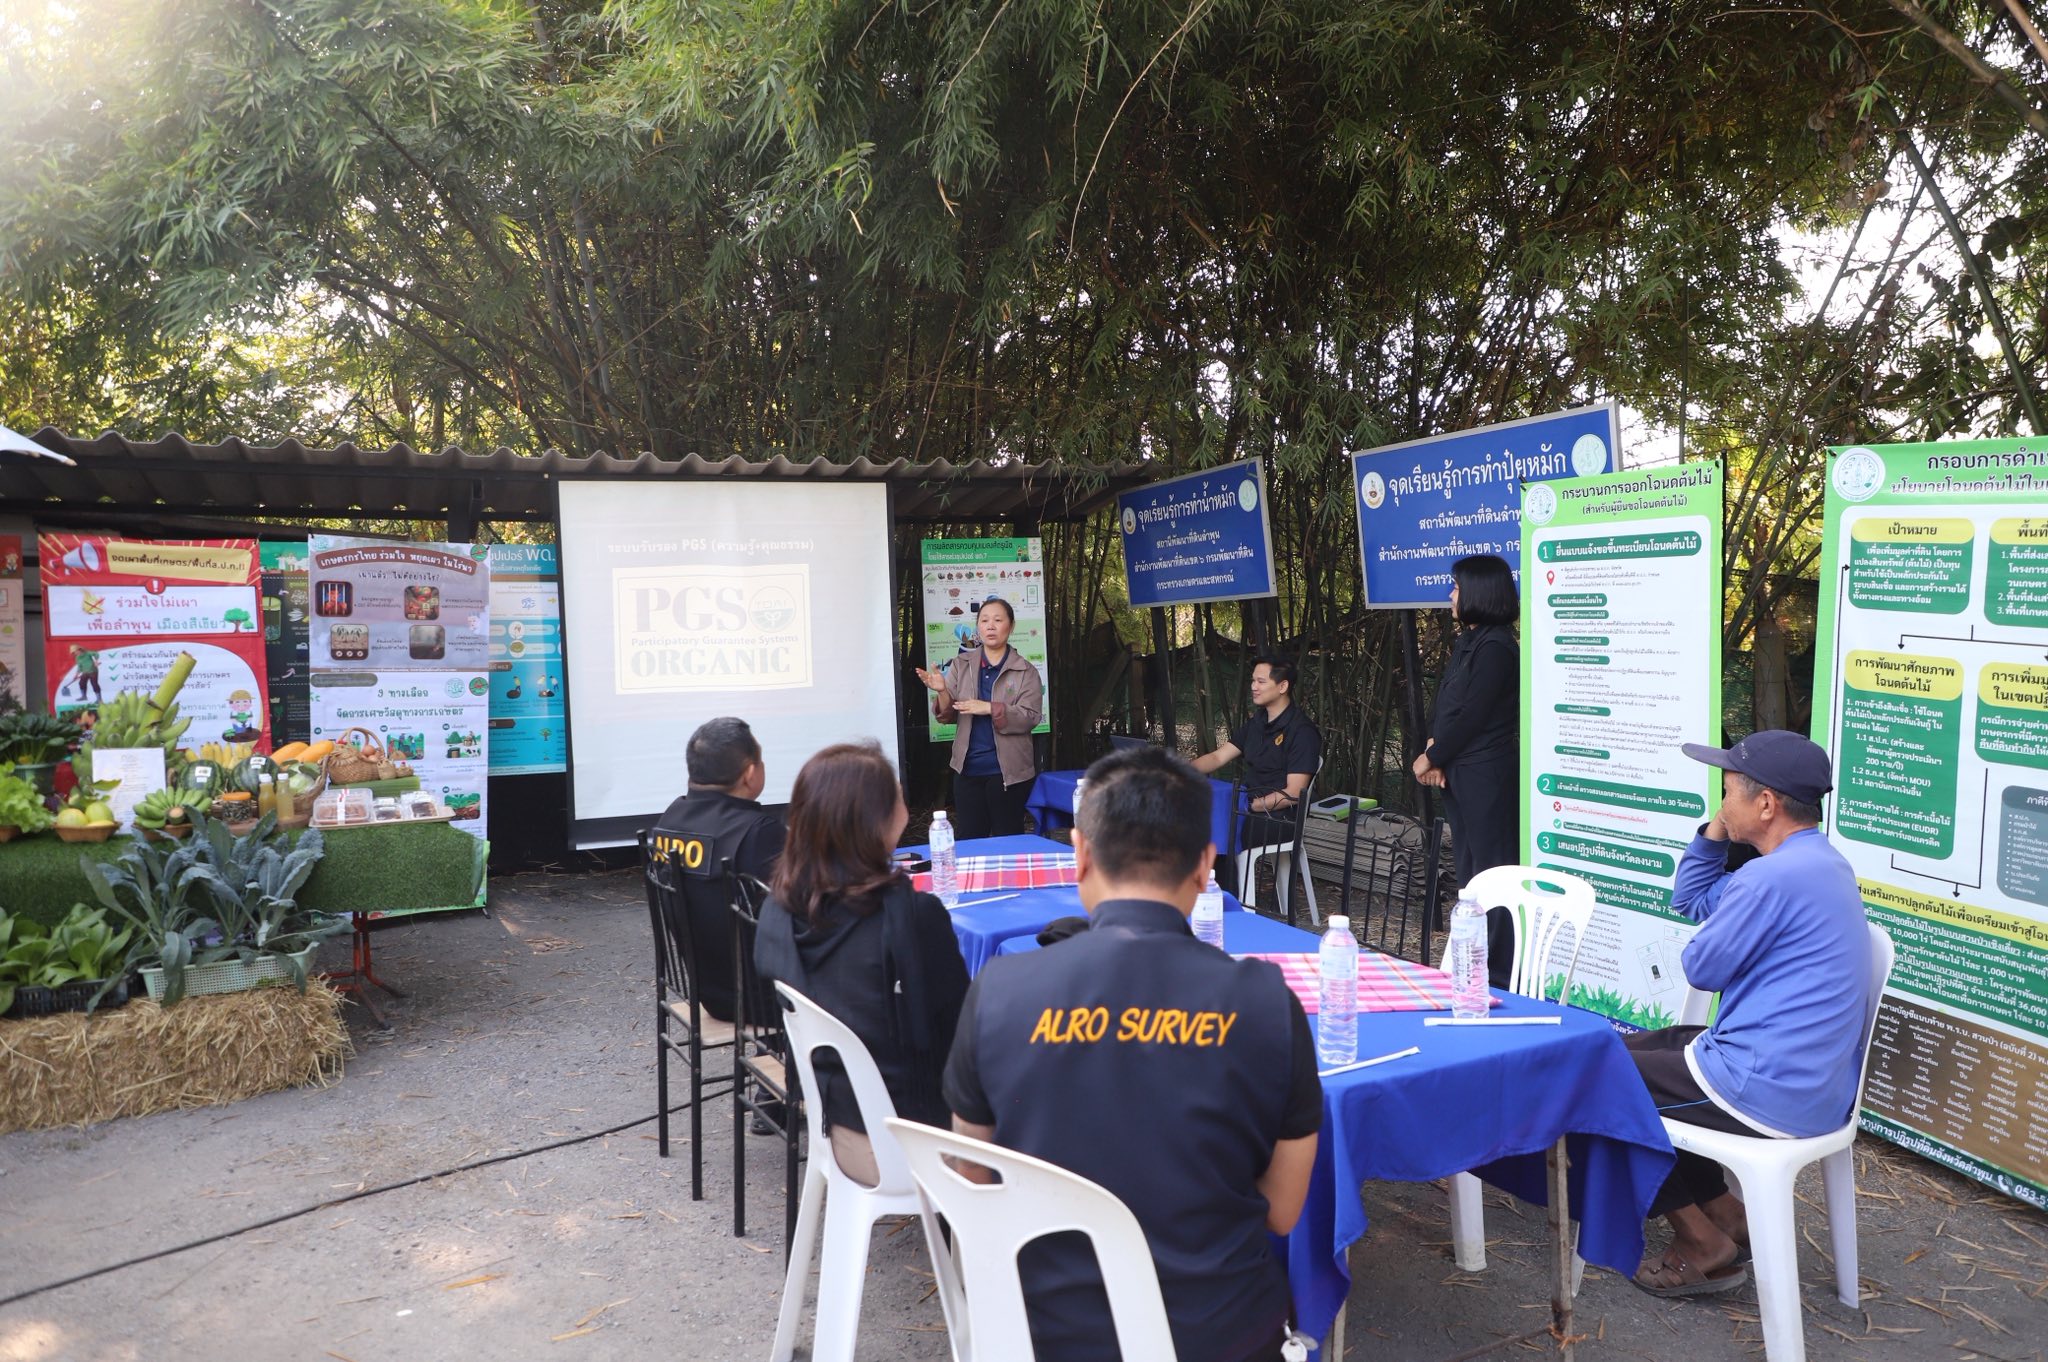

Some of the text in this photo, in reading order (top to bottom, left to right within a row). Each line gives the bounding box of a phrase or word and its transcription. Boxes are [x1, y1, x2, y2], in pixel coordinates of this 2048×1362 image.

[1927, 447, 2048, 470] กรอบการดำเ
[1389, 444, 1566, 506] จุดเรียนรู้การทำปุ๋ยหมัก
[1562, 467, 1712, 500] กระบวนการออกโฉนดต้นไม้
[1891, 474, 2048, 494] นโยบายโฉนดต้นไม้ใน
[1138, 481, 1236, 531] จุดเรียนรู้การทำน้ำหมัก
[1582, 494, 1688, 515] (สำหรับผู้ยื่นขอโฉนดต้นไม้)
[1419, 505, 1521, 530] สถานีพัฒนาที่ดินลำพู
[1888, 522, 1937, 535] เป้าหมาย
[682, 538, 706, 551] PGS
[1157, 528, 1220, 549] สถานีพัฒนาที่ดินลำพูน
[1379, 536, 1490, 561] สำนักงานพัฒนาที่ดินเขต
[1543, 546, 1549, 559] 1
[1934, 546, 1962, 556] โดยการ
[321, 550, 377, 567] เกษตรกรไทย
[379, 550, 405, 560] ร่วมใจ
[410, 553, 440, 565] หยุดเผา
[1905, 557, 1932, 568] (ต้นไม้)
[116, 594, 198, 608] ร่วมใจไม่เผา
[631, 586, 748, 634] PGS
[88, 618, 151, 636] เพื่อลำพูน
[632, 633, 799, 649] Participatory Guarantee Systems
[630, 646, 791, 677] ORGANIC
[1855, 657, 1955, 677] การพัฒนาศักยภาพ
[1875, 674, 1931, 693] โฉนดต้นไม้
[1856, 733, 1866, 742] 1.1
[1866, 757, 1880, 766] 200
[1542, 778, 1550, 792] 2
[1852, 777, 1863, 786] 1.3
[1853, 766, 1864, 775] 1.2
[1909, 776, 1931, 787] MOU)
[1912, 822, 1939, 836] (EUDR)
[1542, 837, 1550, 850] 3
[1893, 928, 1919, 940] 10,000
[1983, 966, 2006, 978] 1,000
[2008, 972, 2025, 984] บาท
[2018, 1001, 2047, 1017] 36,000
[1029, 1006, 1237, 1047] ALRO SURVEY
[2035, 1018, 2045, 1029] 10
[2027, 1050, 2036, 1061] 2)
